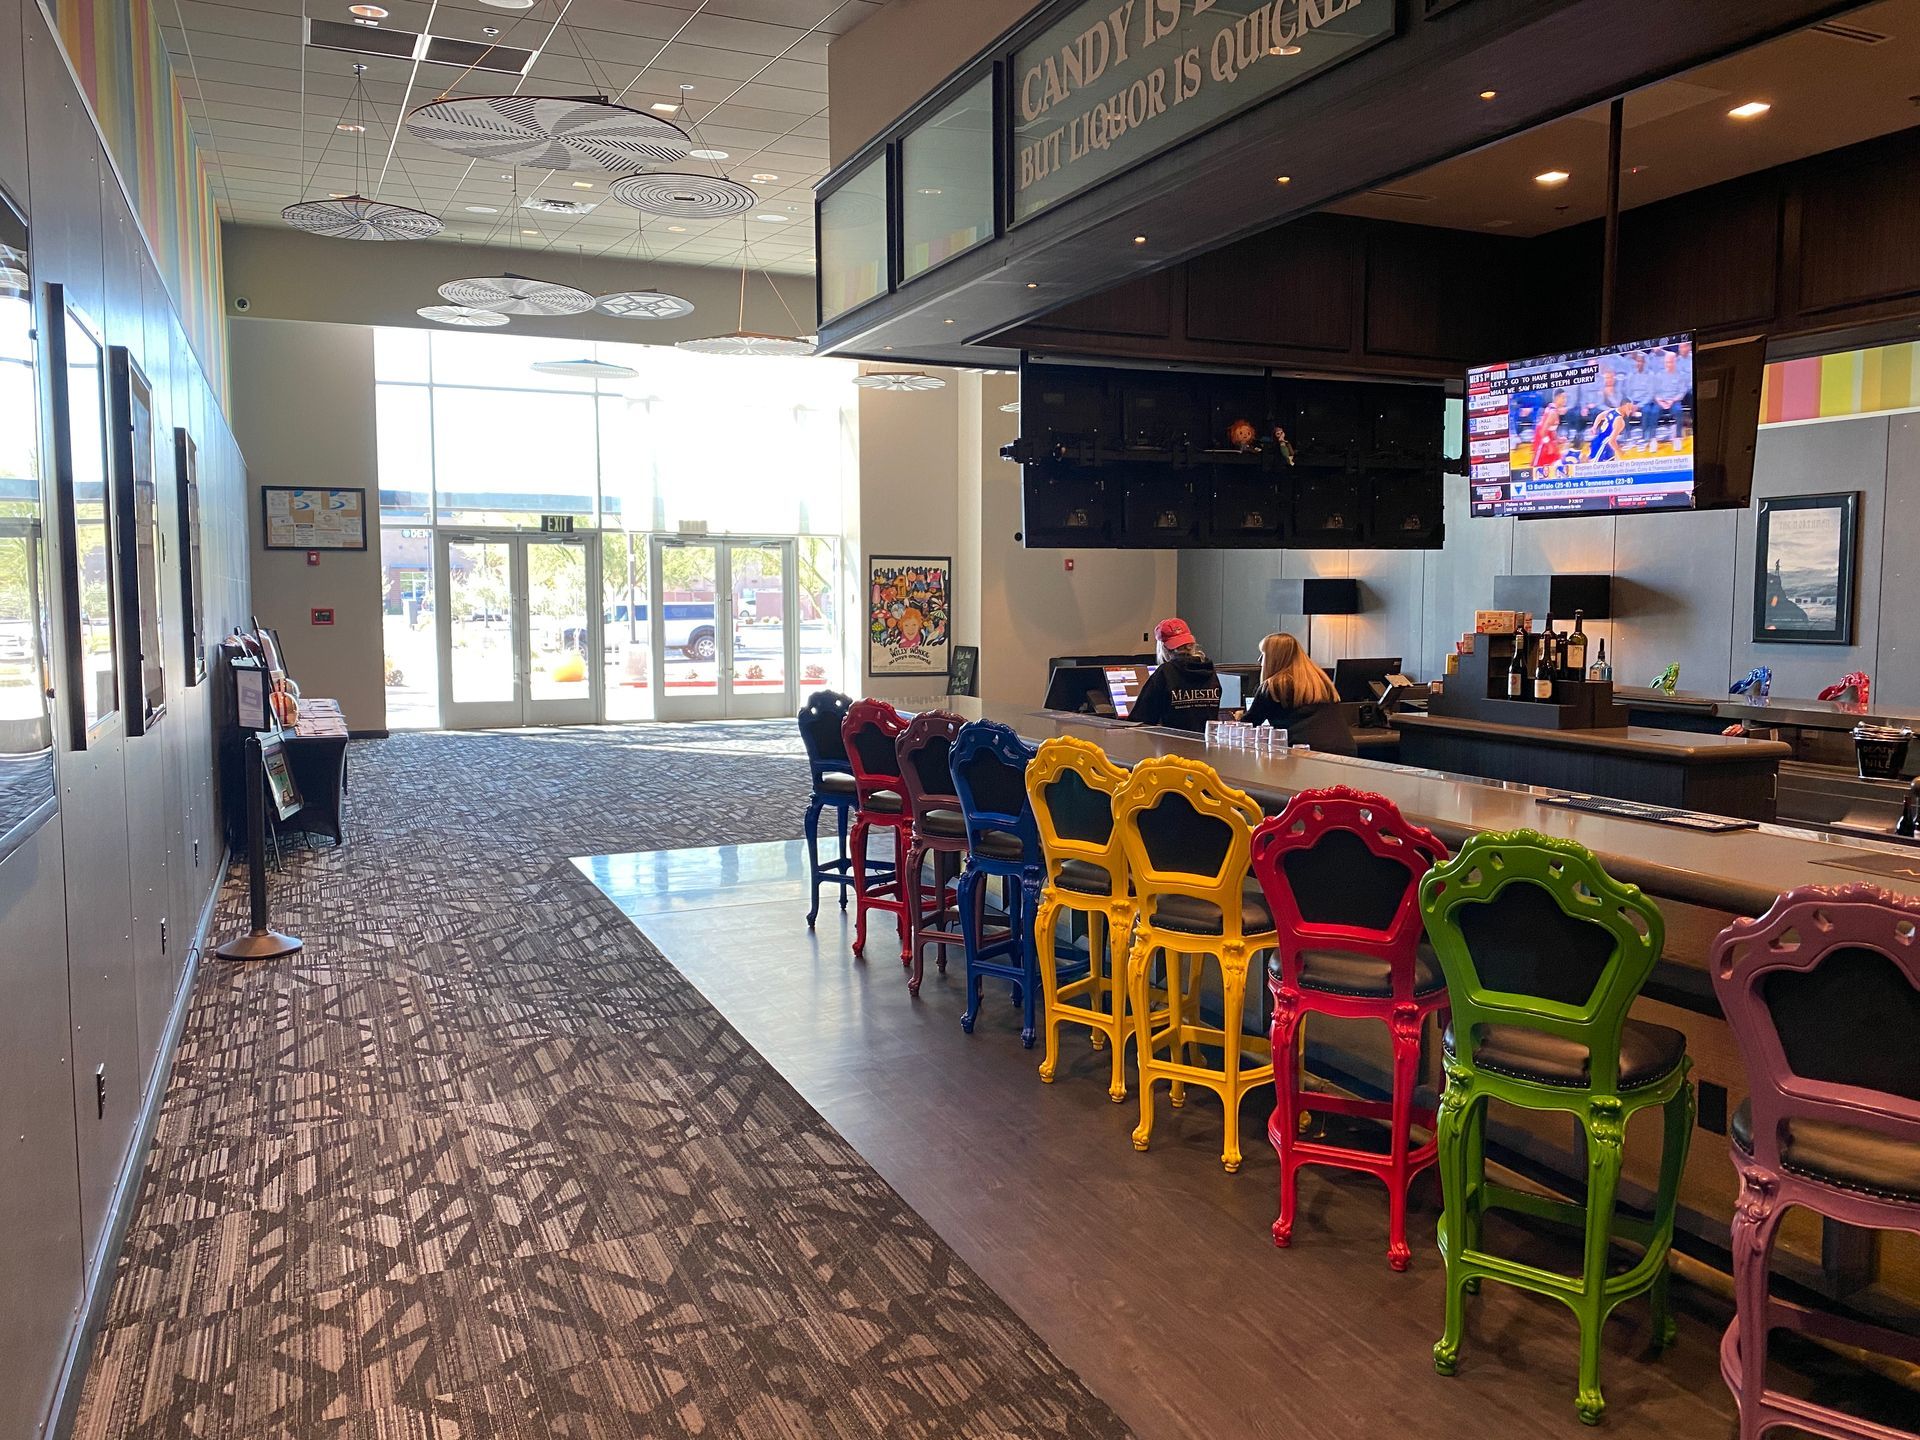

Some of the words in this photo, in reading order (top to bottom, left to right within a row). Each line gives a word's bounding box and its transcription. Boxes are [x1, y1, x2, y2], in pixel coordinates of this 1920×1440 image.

[1021, 0, 1134, 121] CANDY
[1143, 0, 1181, 48] IS
[1020, 126, 1065, 190] BUT
[1069, 68, 1167, 163] LIQUOR
[1173, 46, 1202, 106] IS
[1209, 0, 1361, 83] QUICK
[1490, 379, 1508, 388] LET'S
[1510, 377, 1519, 385] GO
[1532, 373, 1547, 382] HAVE
[1550, 371, 1563, 379] NBA
[1565, 369, 1578, 377] AND
[1580, 366, 1598, 374] WHAT
[1490, 388, 1505, 396] WHAT
[1518, 384, 1530, 392] SAW
[1532, 382, 1548, 390] FROM
[1550, 379, 1570, 388] STEPH
[1573, 375, 1594, 385] CURRY
[1534, 482, 1553, 490] Buffalo
[1615, 477, 1634, 485] (23-8)
[547, 516, 568, 532] EXIT
[1171, 687, 1219, 702] MAJESTIC
